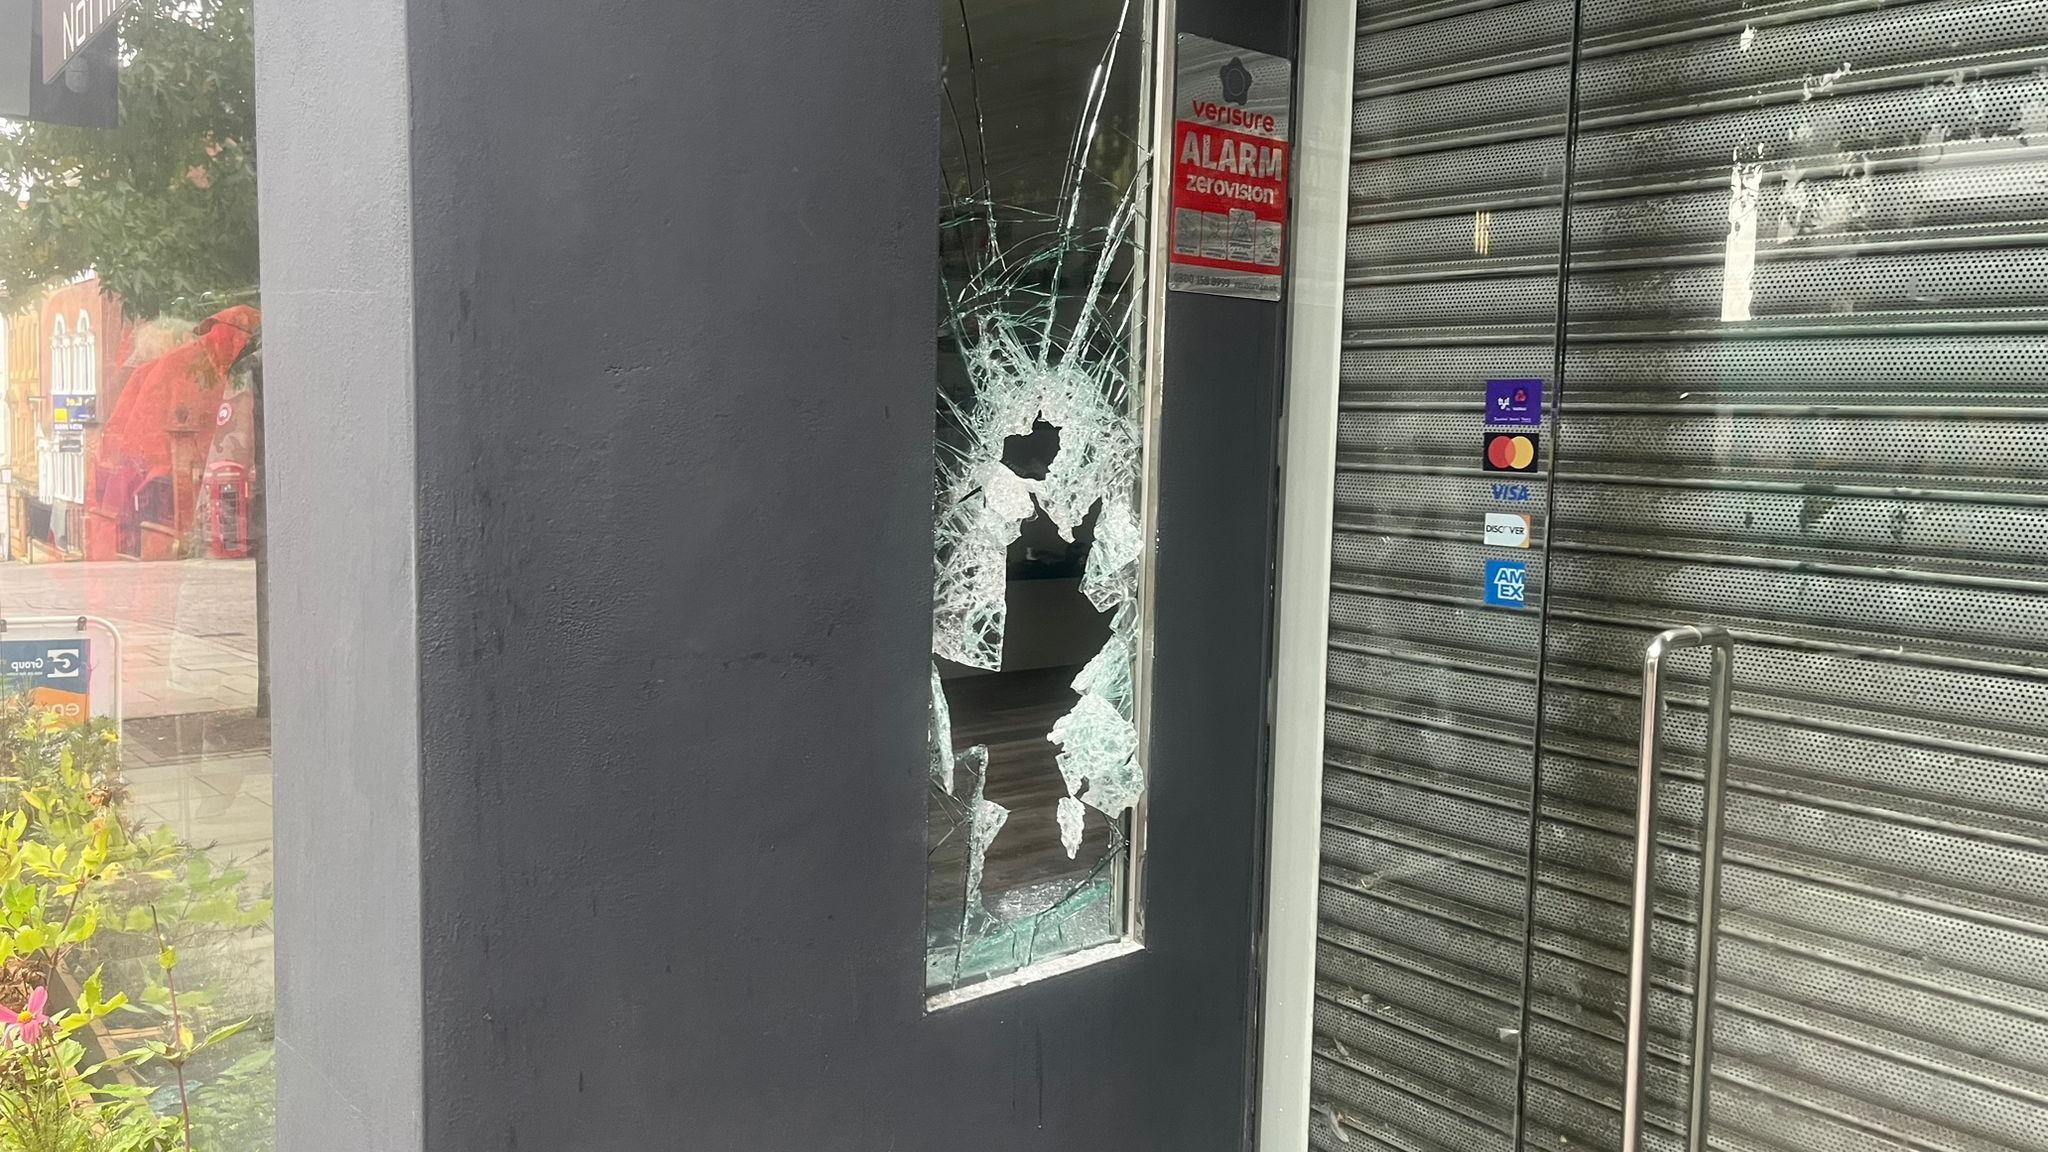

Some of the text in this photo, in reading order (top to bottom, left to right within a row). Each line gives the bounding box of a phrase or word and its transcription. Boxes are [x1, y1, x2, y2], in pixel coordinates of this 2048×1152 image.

[1193, 99, 1275, 132] verisure
[1180, 130, 1283, 182] ALARM
[1186, 174, 1276, 205] zerovision
[1491, 483, 1529, 500] VISA
[1486, 524, 1525, 535] DISCVER
[1494, 567, 1526, 586] AM
[1497, 584, 1525, 601] EX
